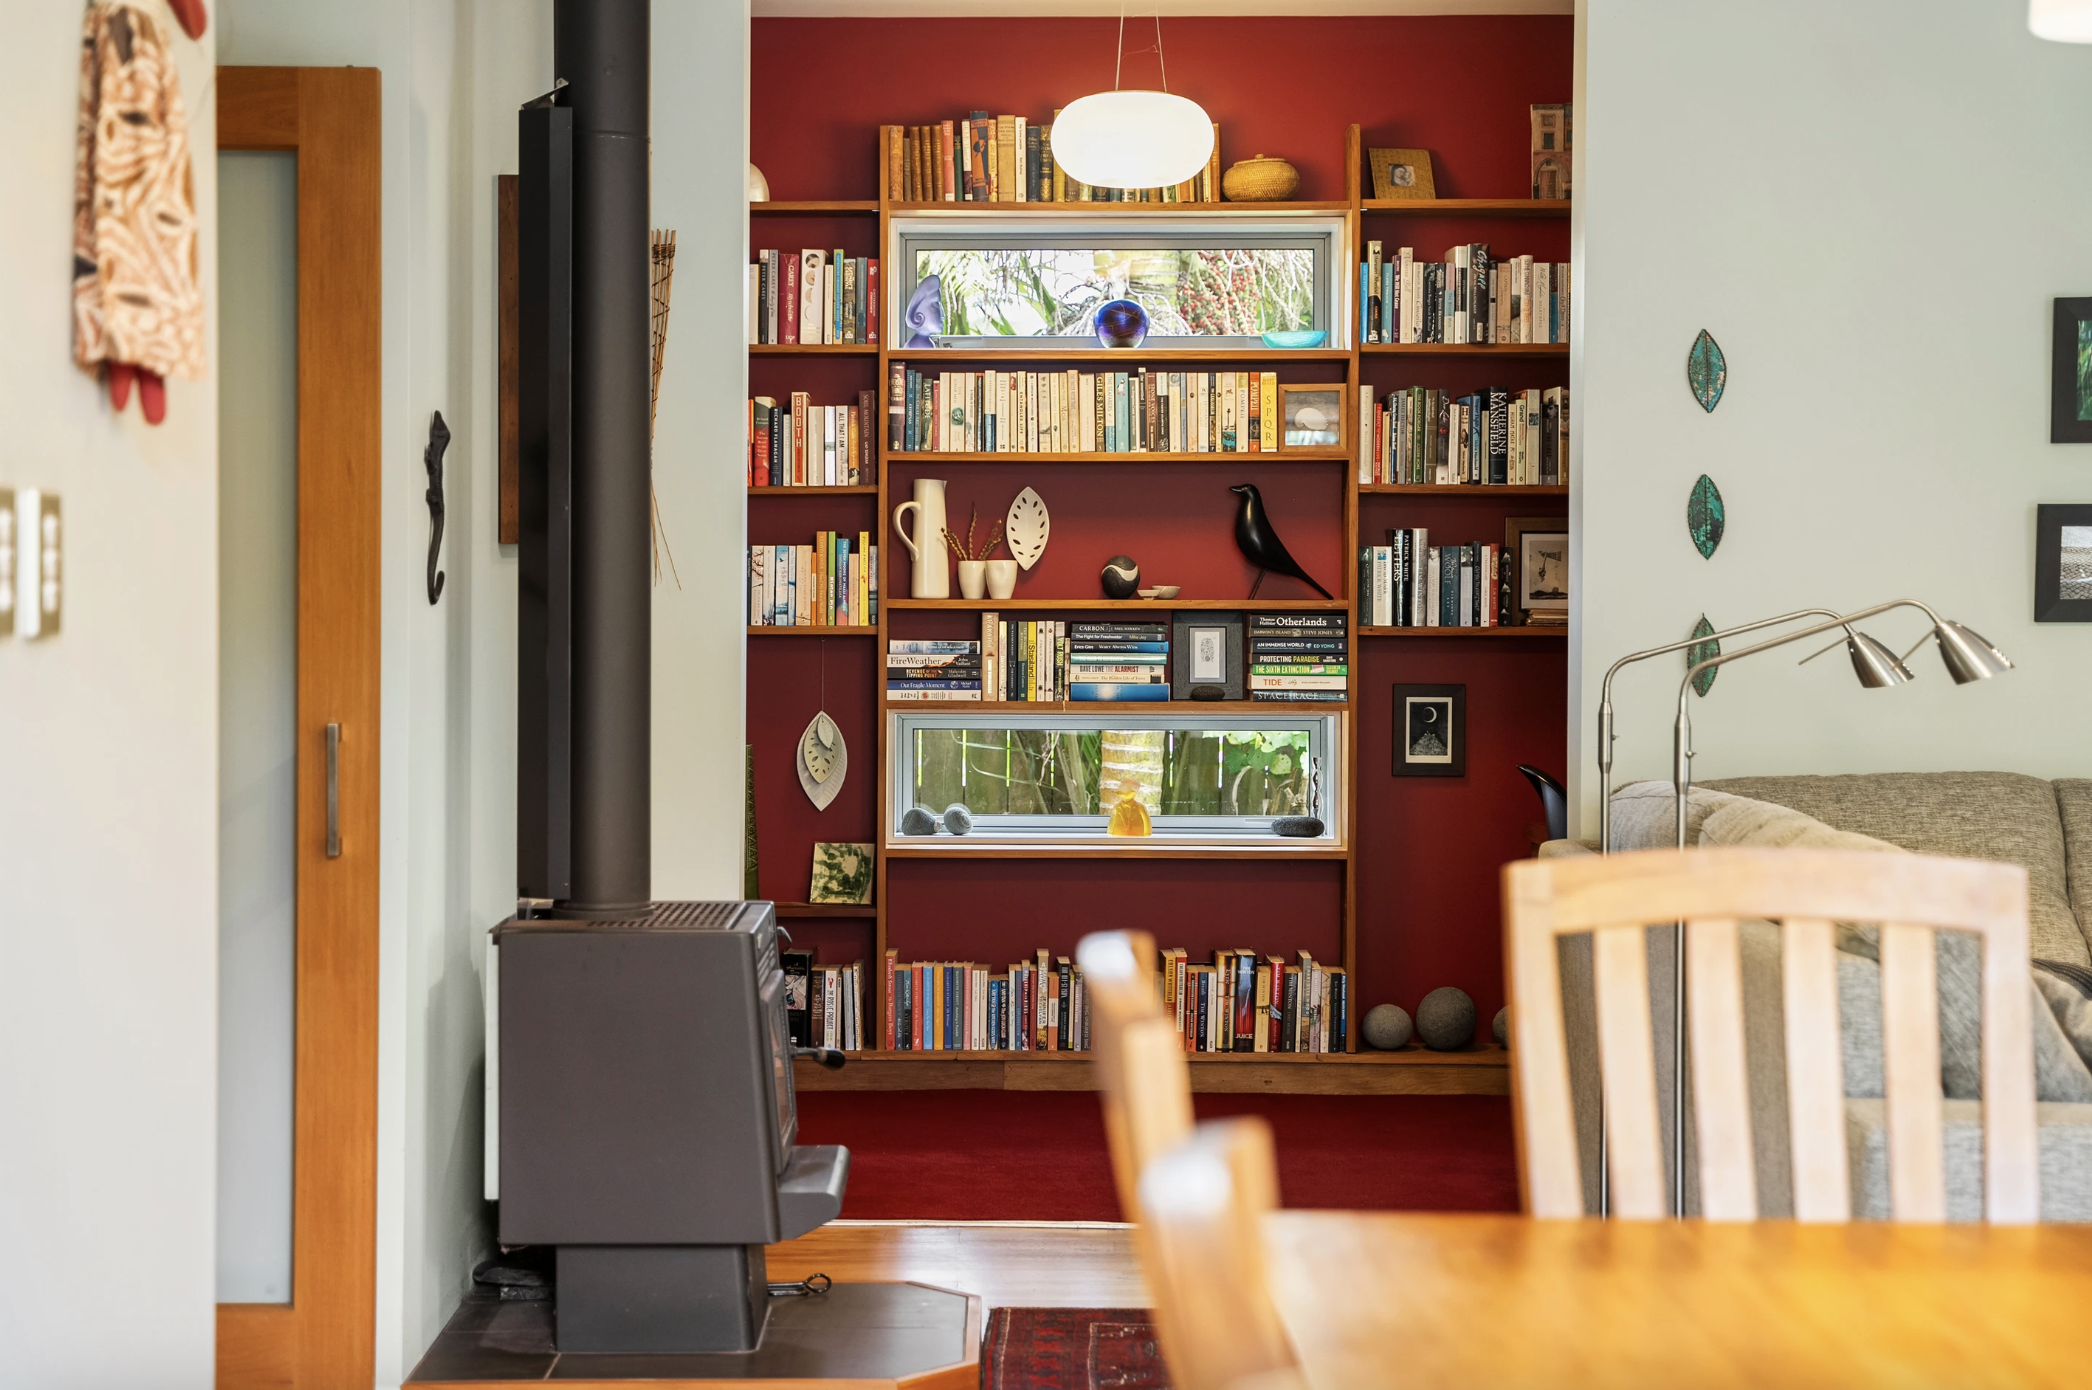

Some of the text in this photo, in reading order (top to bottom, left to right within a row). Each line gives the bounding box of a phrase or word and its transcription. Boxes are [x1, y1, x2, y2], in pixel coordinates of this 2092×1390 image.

[1473, 250, 1487, 289] Chagall
[1490, 392, 1499, 455] MANSFIELD
[1499, 392, 1507, 455] KATHERINE
[839, 439, 845, 448] AM
[1394, 536, 1402, 581] LETTERS
[1276, 617, 1327, 626] Otherlands
[1256, 665, 1310, 673] THE SIXTH EXTINCTION
